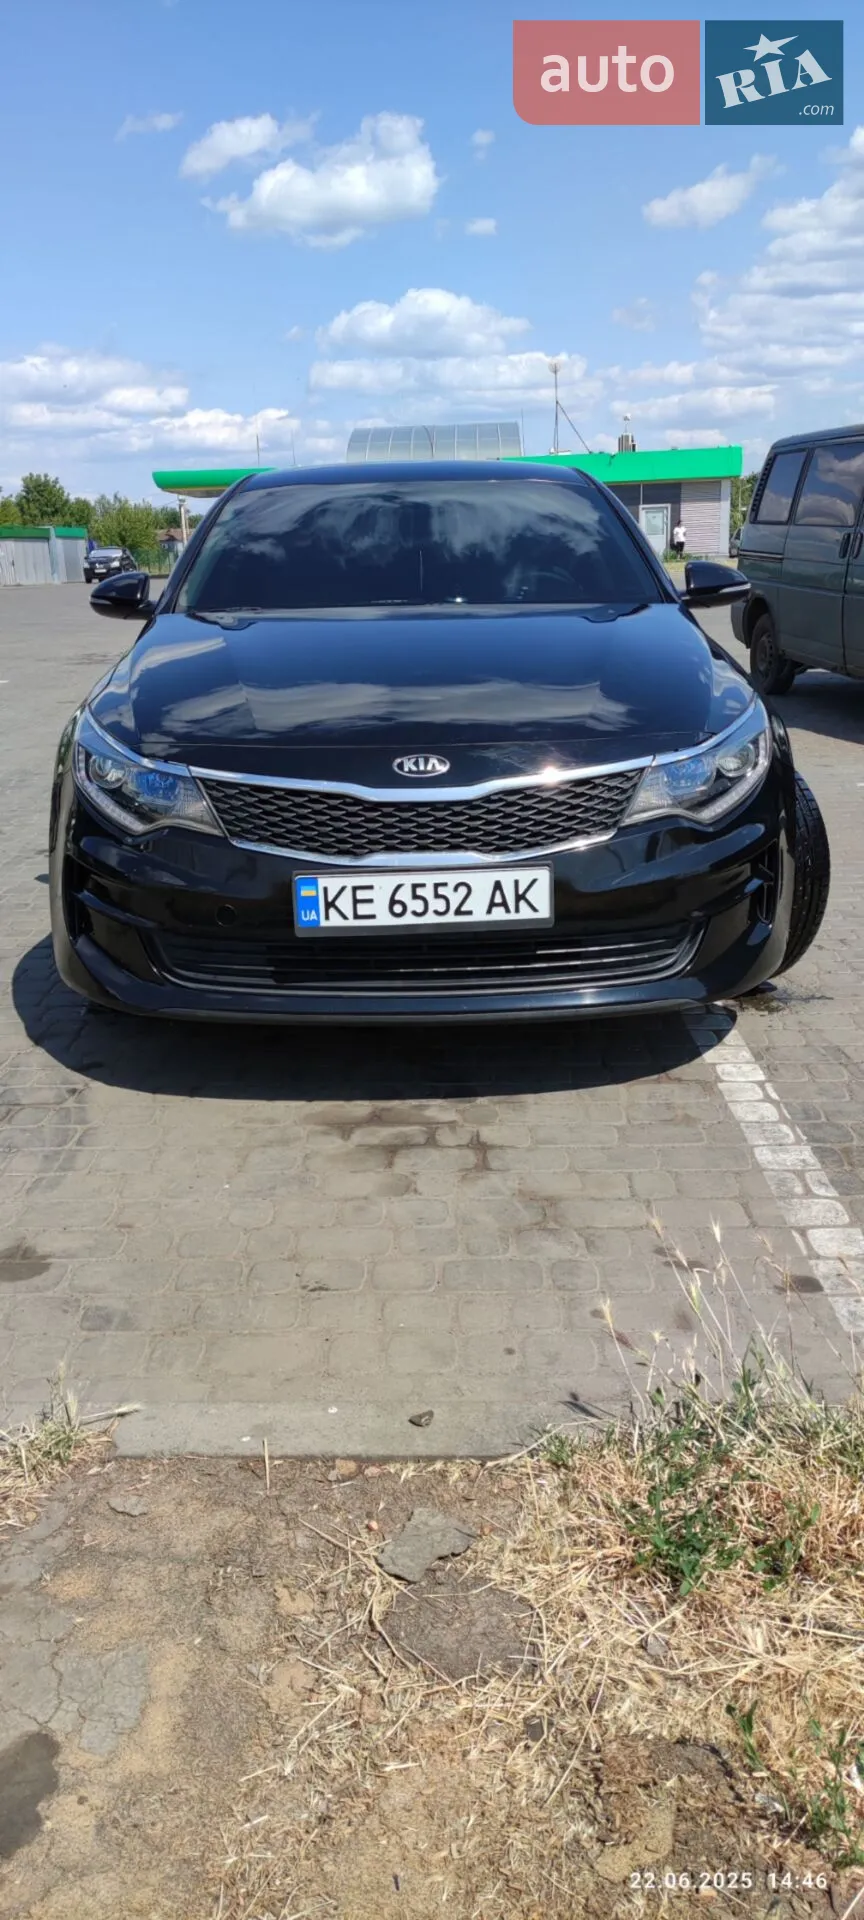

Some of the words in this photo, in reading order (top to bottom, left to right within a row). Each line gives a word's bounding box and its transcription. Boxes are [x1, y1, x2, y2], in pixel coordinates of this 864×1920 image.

[403, 757, 442, 772] KIA
[322, 885, 377, 921] KE
[388, 881, 473, 918] 6552
[485, 878, 540, 915] AK
[301, 909, 318, 921] UA
